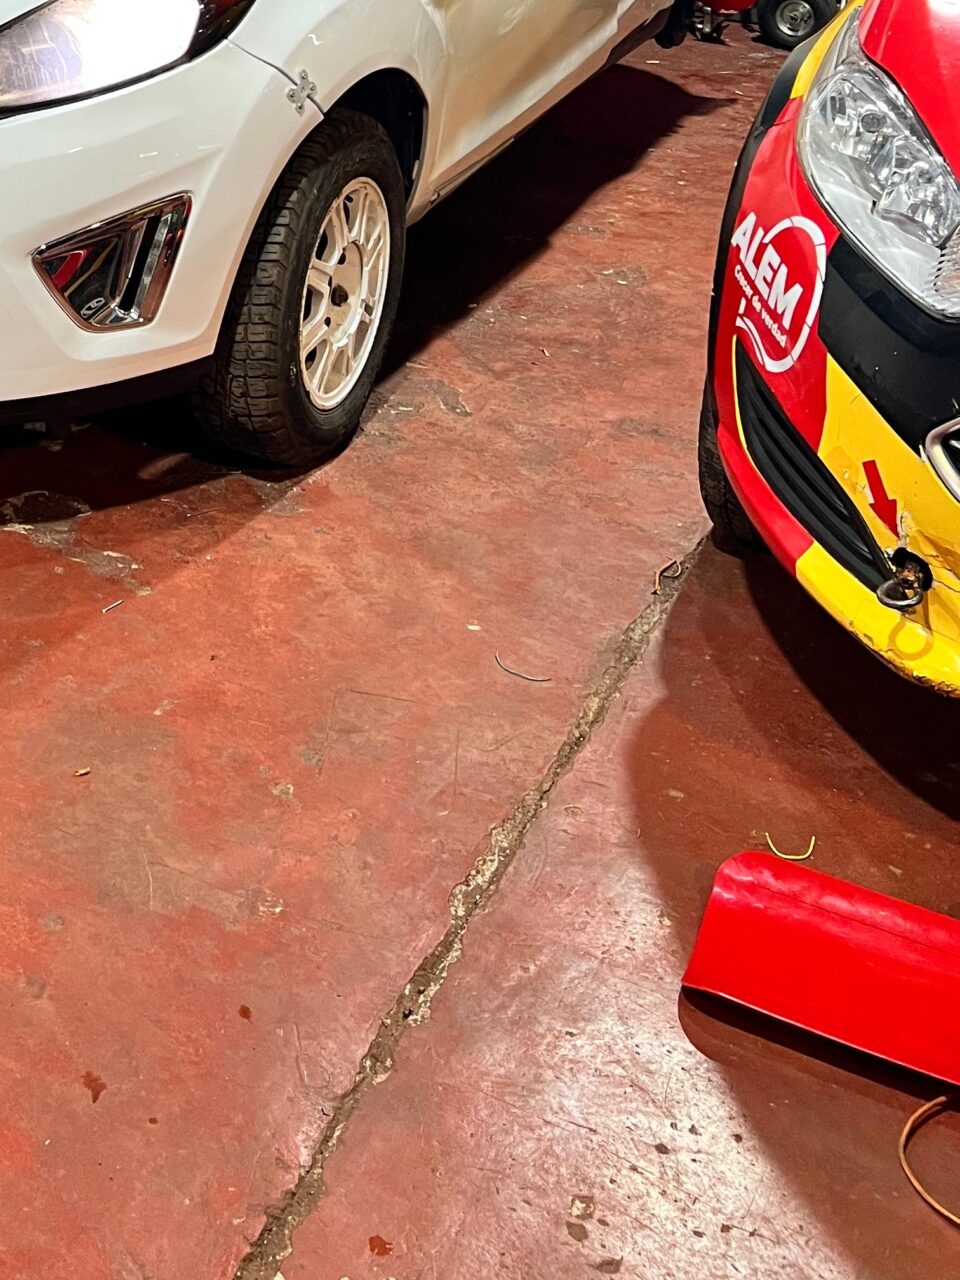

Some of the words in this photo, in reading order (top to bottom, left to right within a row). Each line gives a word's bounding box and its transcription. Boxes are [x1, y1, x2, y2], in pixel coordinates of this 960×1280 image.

[731, 211, 803, 330] ALEM
[734, 264, 753, 299] Crecer
[752, 295, 761, 312] de
[761, 308, 787, 348] verdad
